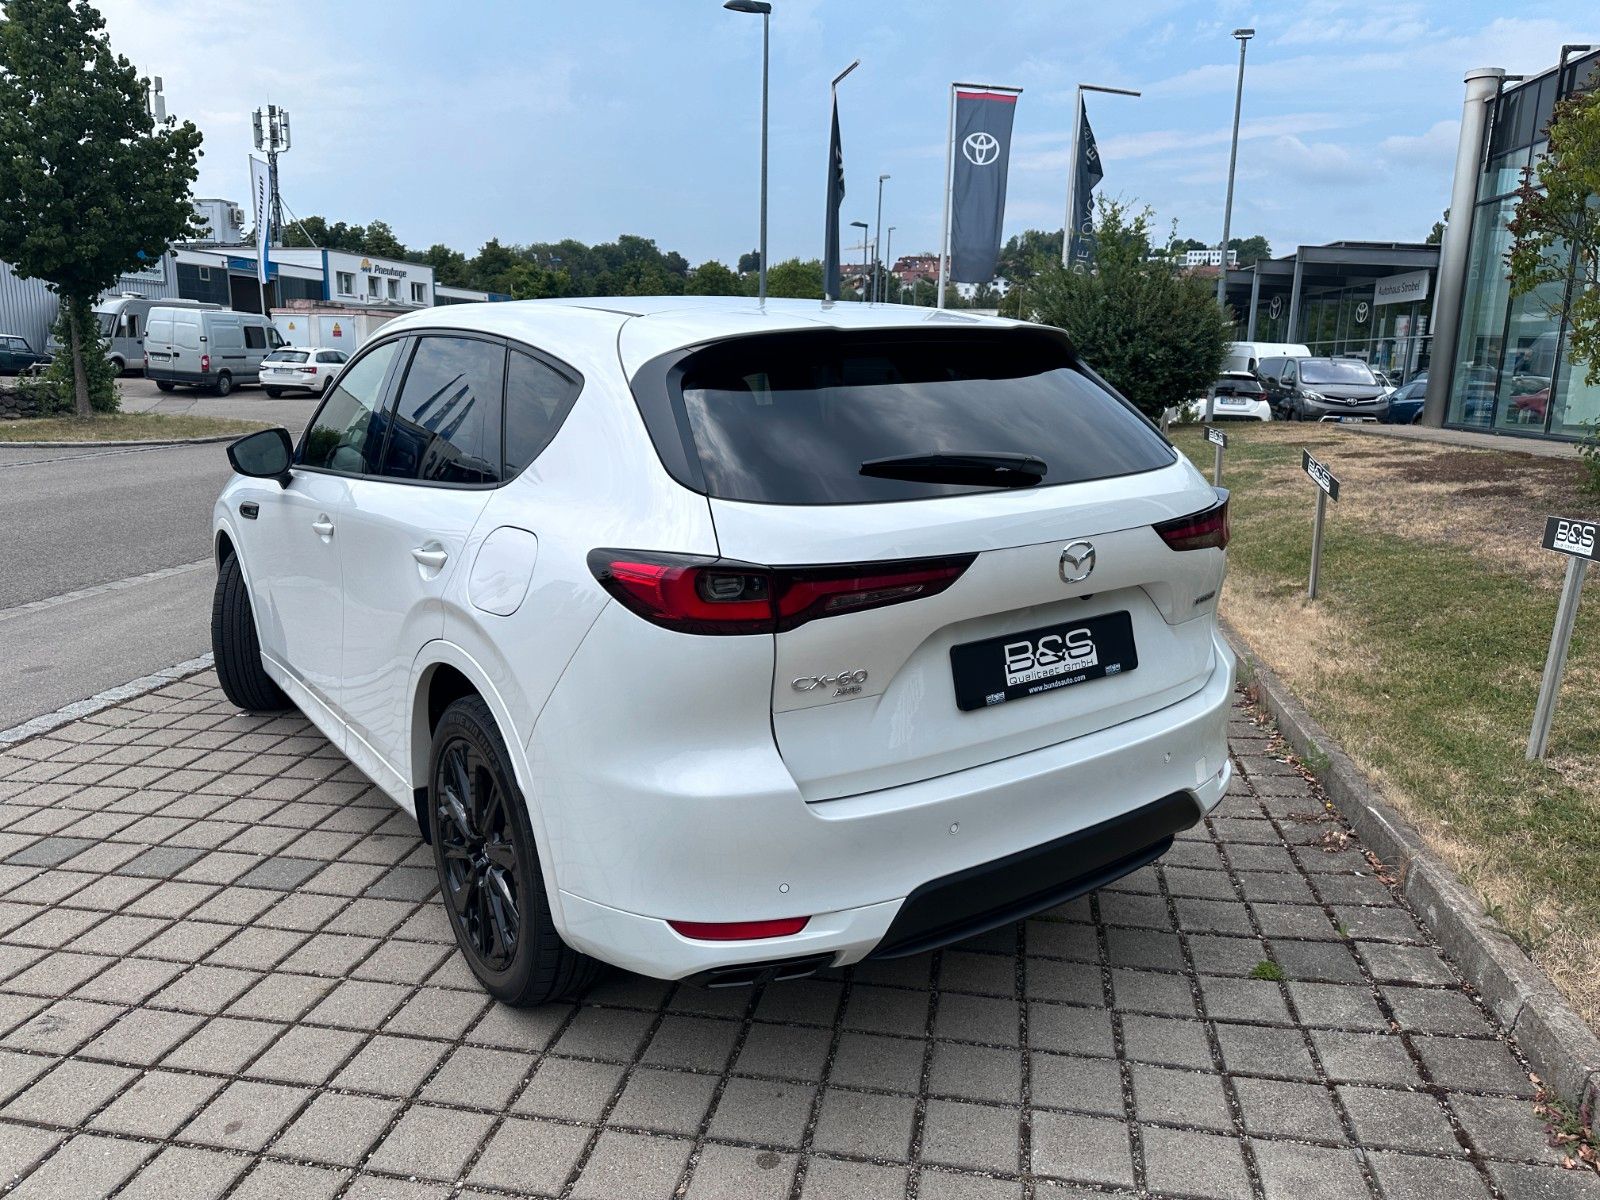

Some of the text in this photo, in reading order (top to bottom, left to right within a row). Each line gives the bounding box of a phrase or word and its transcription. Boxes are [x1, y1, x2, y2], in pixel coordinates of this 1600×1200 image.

[374, 265, 407, 278] Pneuhage
[1378, 280, 1421, 295] Autohaus Strobel
[1308, 457, 1330, 488] B&S
[1556, 521, 1595, 547] B&S
[1003, 628, 1095, 675] B&S
[791, 668, 868, 692] CX-60
[1009, 658, 1095, 685] Qualitaet GmbH
[1028, 674, 1086, 694] www.bundsauto.com
